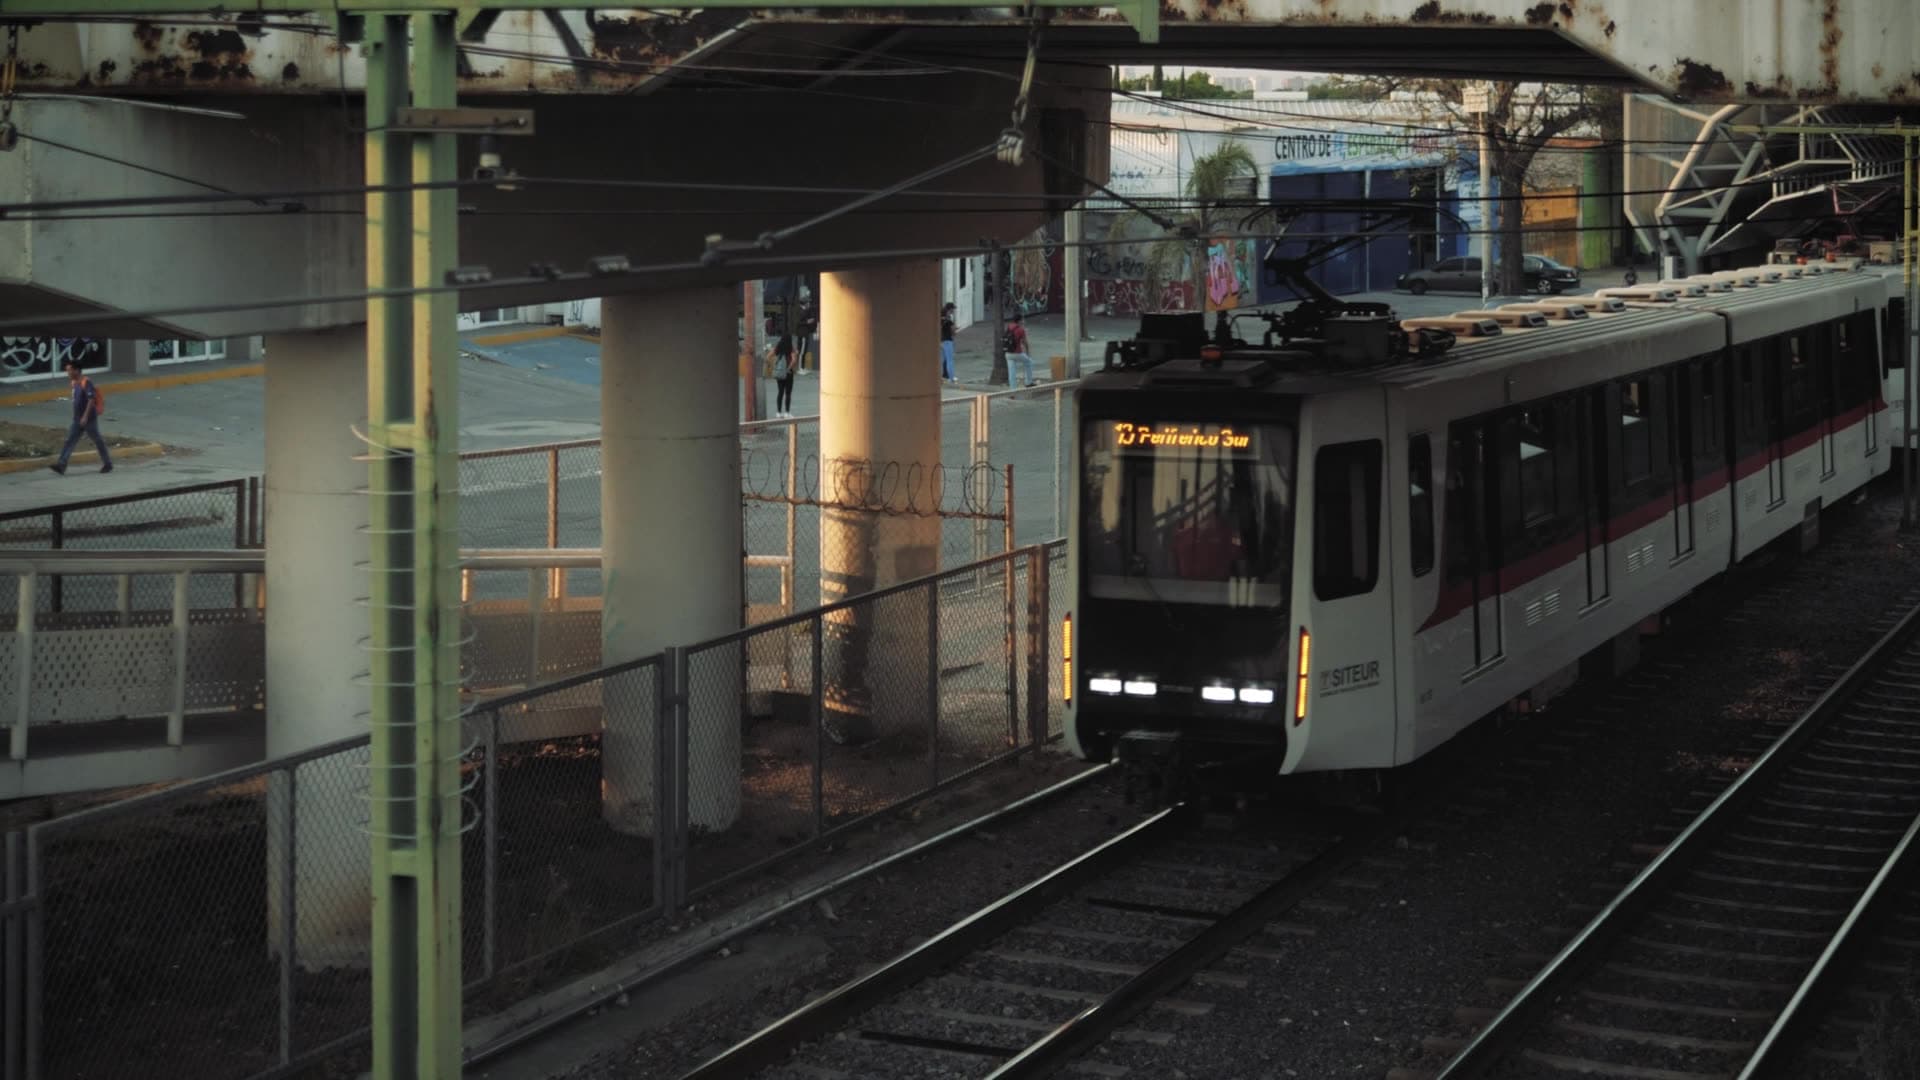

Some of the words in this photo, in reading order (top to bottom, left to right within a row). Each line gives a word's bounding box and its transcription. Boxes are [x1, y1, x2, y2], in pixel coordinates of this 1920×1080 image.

[1275, 135, 1317, 160] CENTRO
[1318, 134, 1331, 157] DE
[1331, 660, 1379, 687] SITEUR
